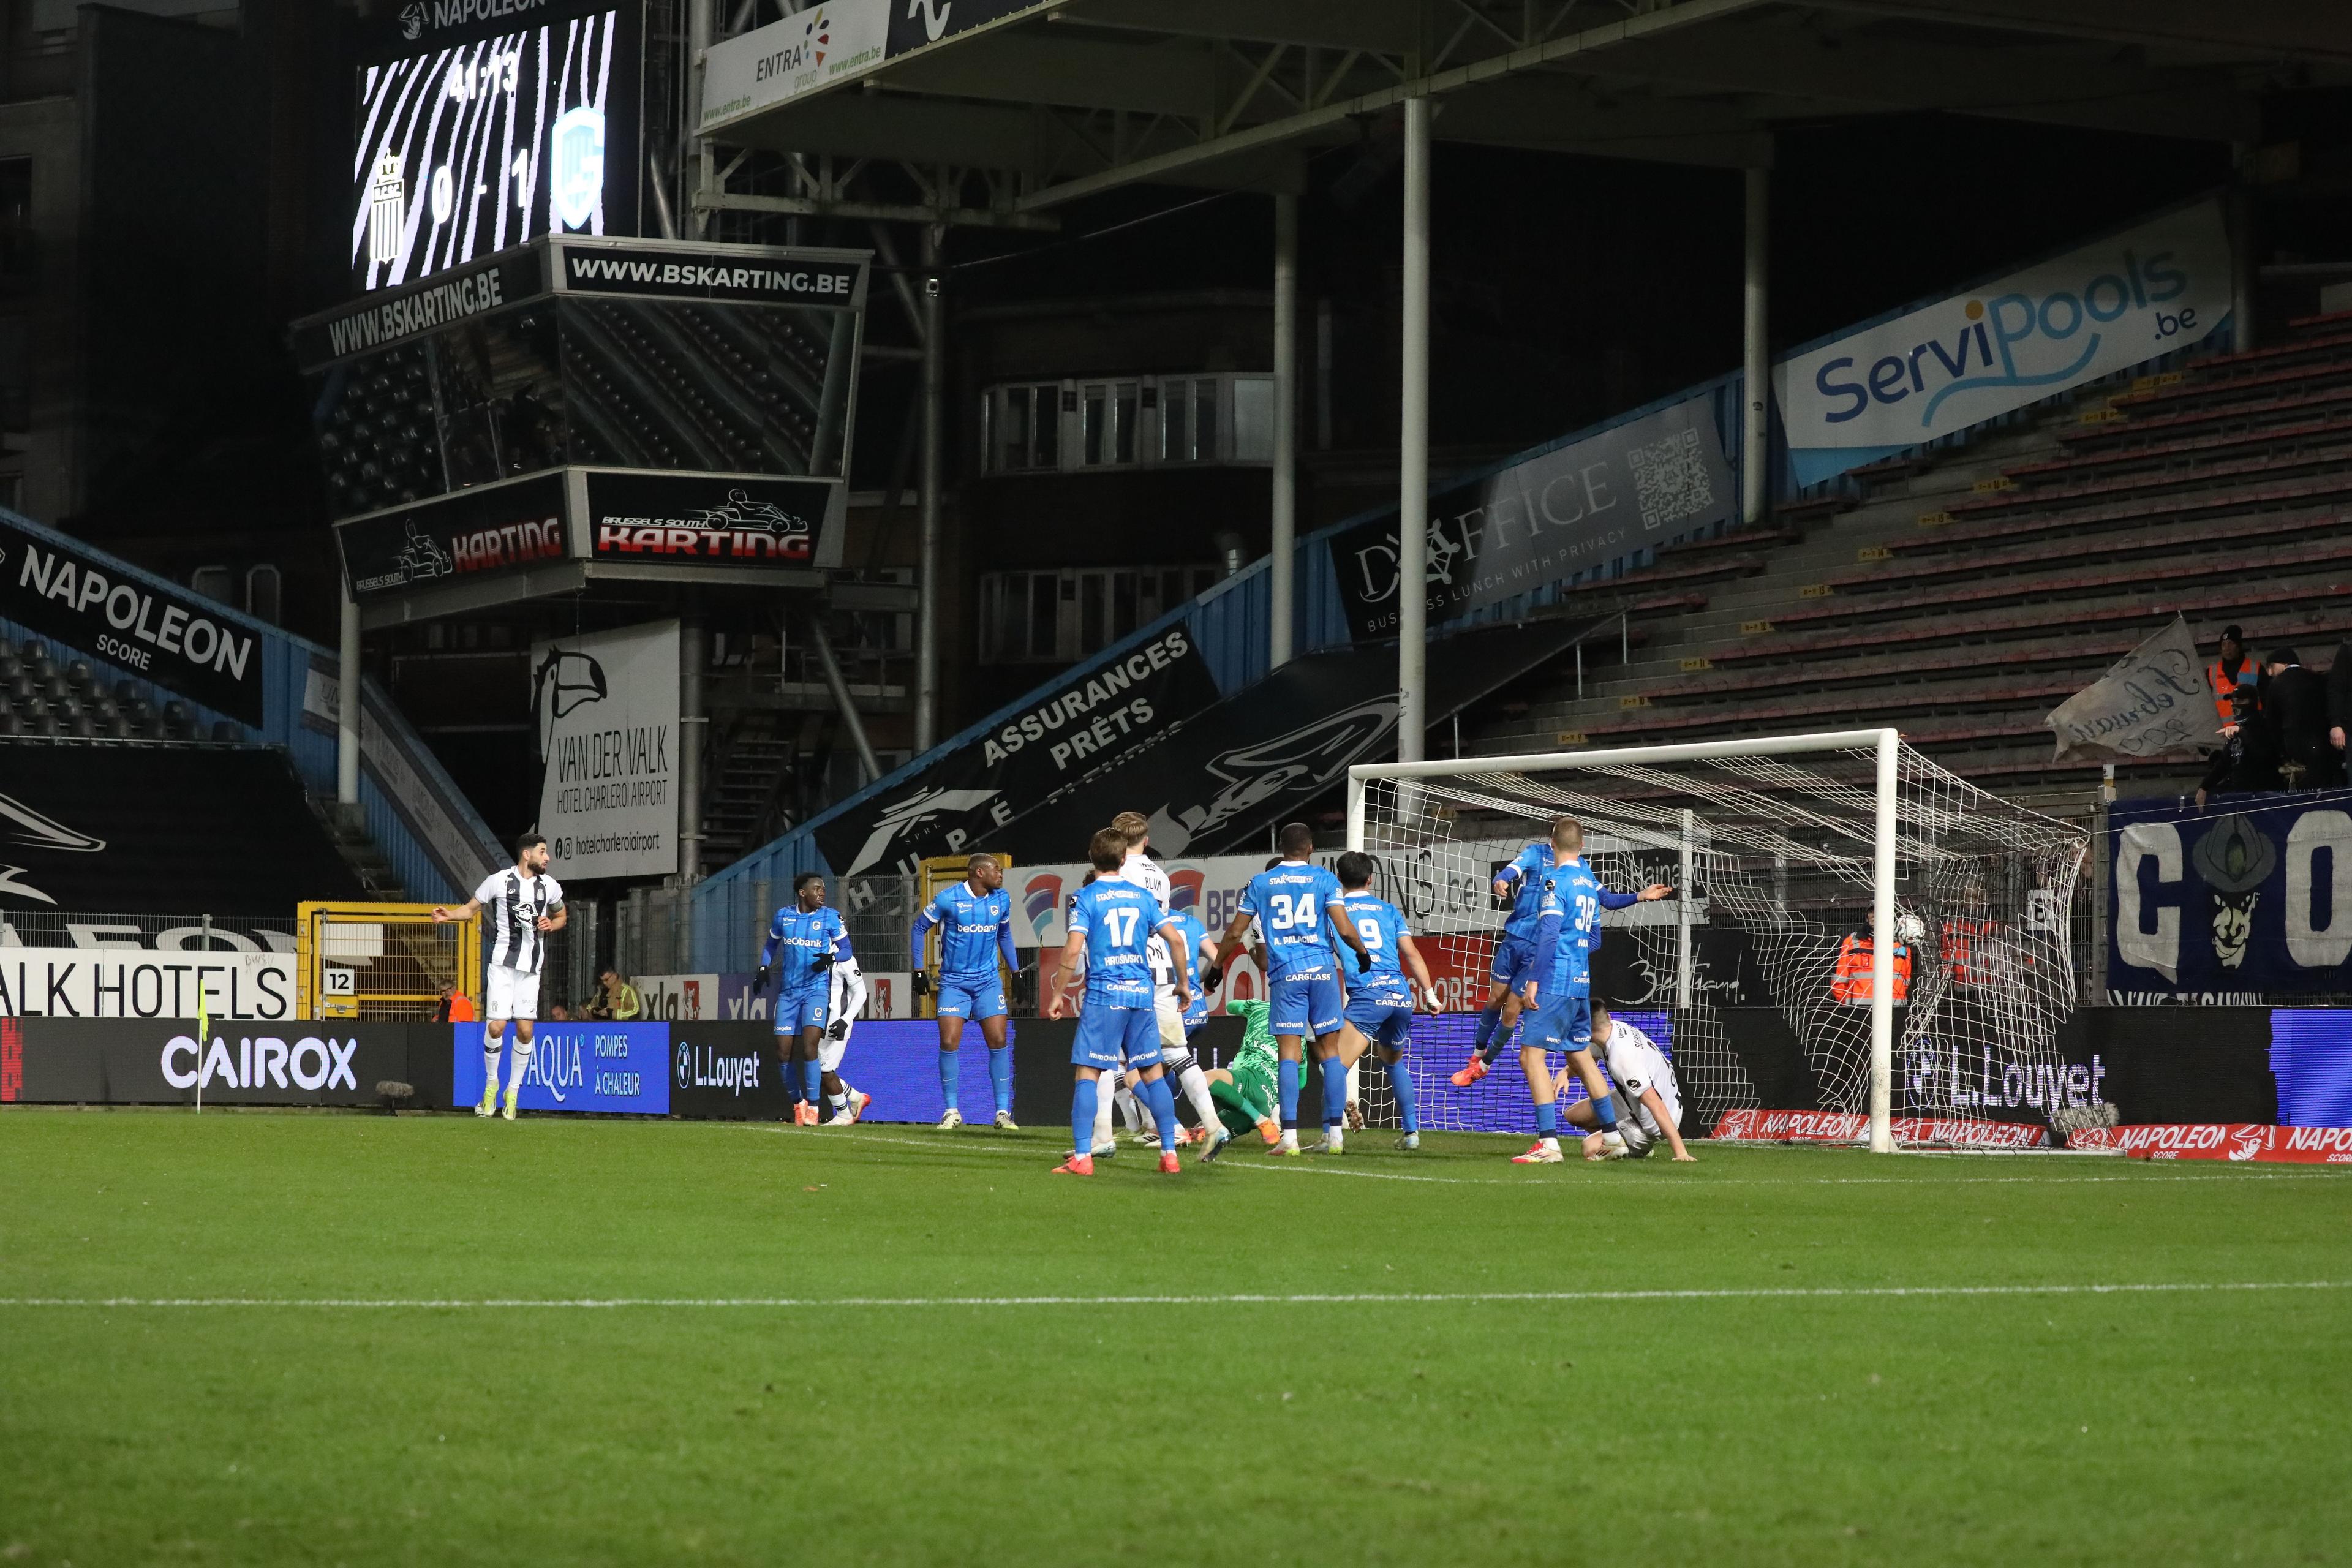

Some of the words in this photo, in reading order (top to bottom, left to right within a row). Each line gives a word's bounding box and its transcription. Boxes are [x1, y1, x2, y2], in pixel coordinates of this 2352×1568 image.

[434, 0, 545, 29] NAPOLE
[448, 51, 518, 102] 41:13
[756, 46, 801, 82] ENTRA
[829, 45, 881, 75] www.entra.be
[794, 68, 817, 93] group
[703, 94, 751, 121] www.entra.be
[432, 165, 453, 224] 0
[512, 149, 527, 207] 1
[572, 257, 850, 295] WWW.BSKARTING.BE
[328, 268, 503, 357] WWW.BSKARTING.BE
[601, 516, 664, 526] BRUSSELS
[666, 519, 706, 528] SOUTH
[451, 517, 562, 572] KARTING
[598, 527, 809, 559] KARTING
[1367, 594, 1444, 633] BUSSS
[1452, 571, 1506, 601] LUNCH
[1512, 558, 1552, 579] WITH
[1559, 527, 1626, 562] PRIVACY
[19, 544, 252, 681] NAPOLEON
[97, 634, 151, 671] SCORE
[984, 631, 1188, 767] ASSURANCES
[1050, 698, 1154, 771] PRÊTS
[558, 734, 588, 783] VAN
[594, 731, 622, 779] DER
[628, 725, 668, 775] VALK
[557, 788, 583, 813] HOTEL
[585, 782, 629, 811] CHARLEROI
[631, 779, 667, 806] AIRPORT
[576, 831, 660, 856] hotelcharleroiairport
[1630, 856, 1700, 894] Hainat
[1104, 908, 1139, 948] 17
[1270, 893, 1317, 929] 34
[1284, 934, 1318, 944] PALACIOS
[1358, 919, 1383, 949] 9
[94, 963, 287, 1020] HOTELS
[330, 973, 349, 989] 12
[1106, 984, 1149, 993] CARGLASS
[1286, 973, 1331, 981] CARGLASS
[1376, 998, 1412, 1008] CARGLASS
[161, 1036, 356, 1090] CAIROX
[595, 1035, 628, 1058] POMPES
[595, 1065, 601, 1095] À
[603, 1072, 640, 1095] CHALEUR
[696, 1046, 760, 1096] L.Louyet
[1951, 1046, 2106, 1124] L.Louyet
[1760, 1112, 1862, 1138] NAPOLEON
[1931, 1123, 2038, 1147] NAPOLEON
[2119, 1126, 2226, 1150] NAPOLEON
[2152, 1151, 2179, 1159] SCORE
